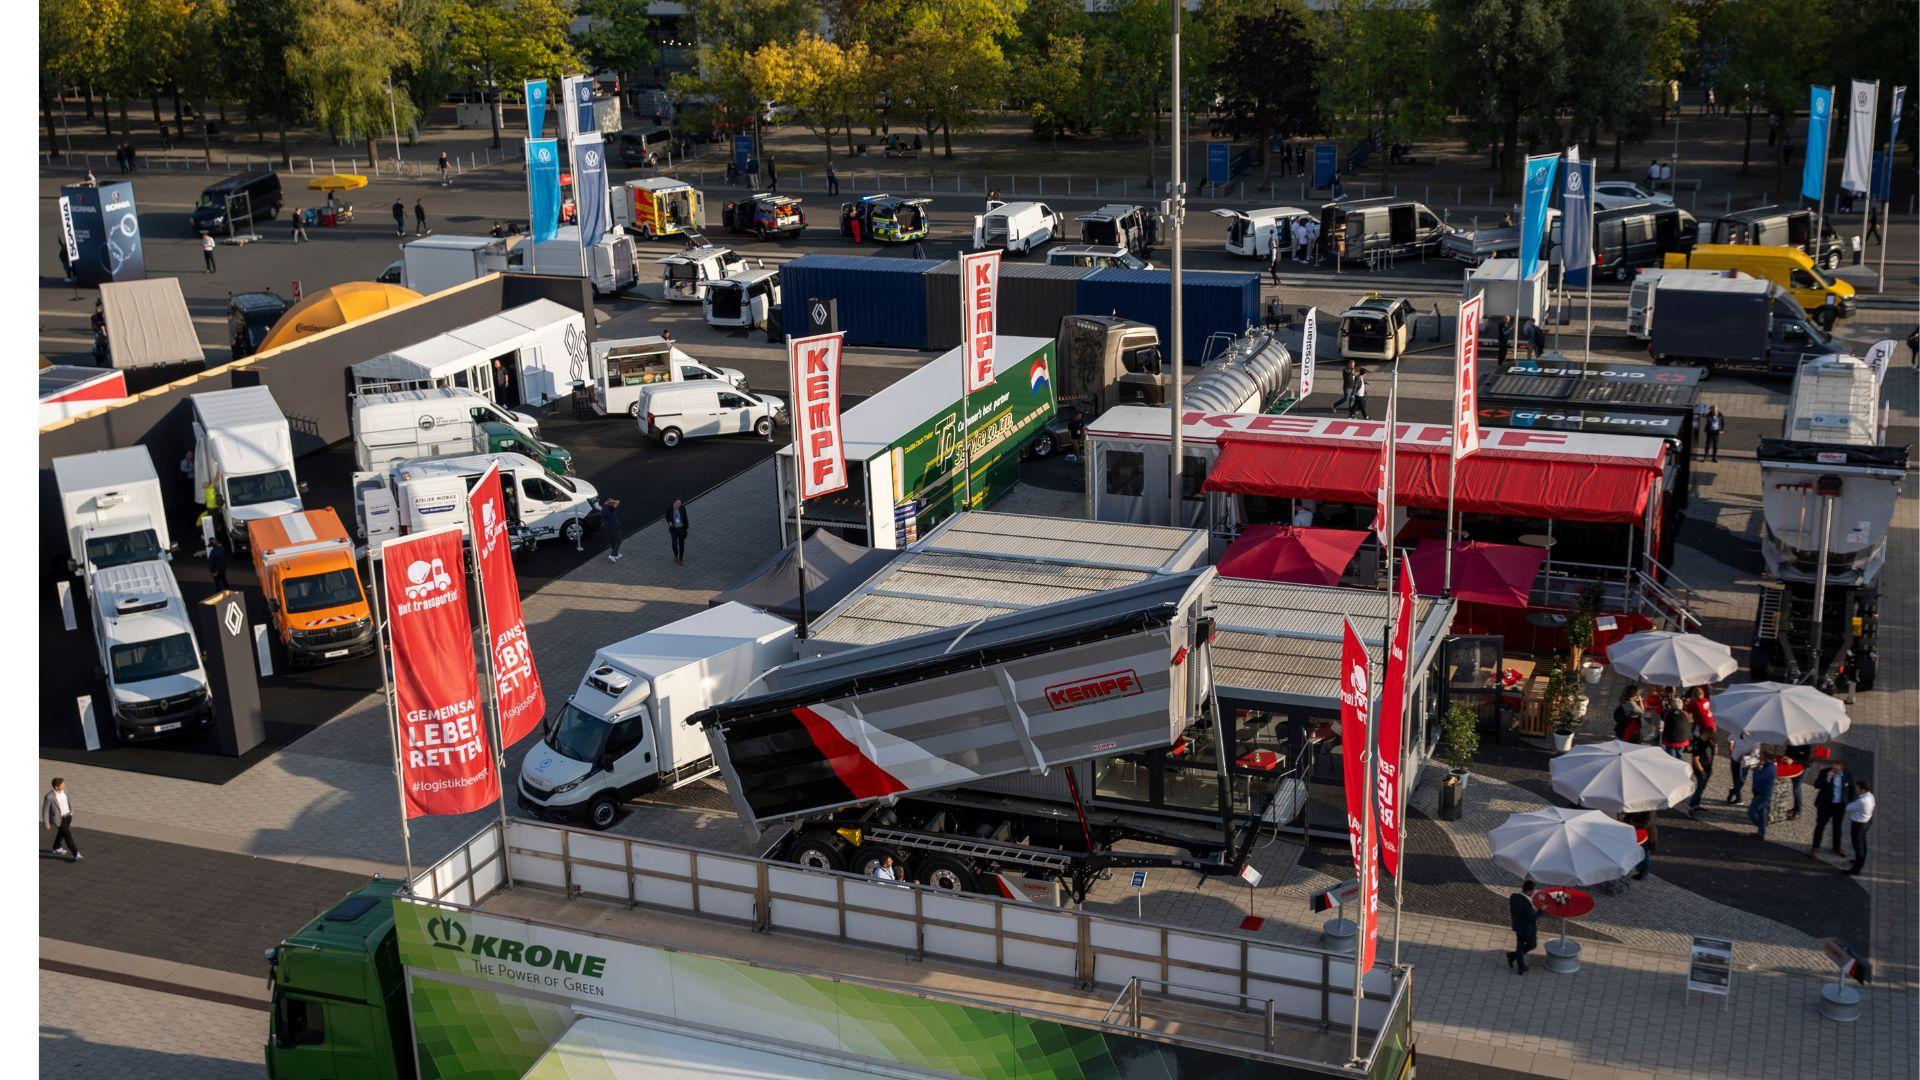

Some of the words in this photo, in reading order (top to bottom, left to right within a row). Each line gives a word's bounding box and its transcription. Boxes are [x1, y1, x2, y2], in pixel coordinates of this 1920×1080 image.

[63, 203, 77, 257] SCANIA
[975, 262, 993, 382] KEMPF
[1507, 365, 1646, 379] crossland
[806, 347, 834, 486] KEMPF
[1515, 411, 1670, 427] crossland
[1050, 676, 1133, 705] KEMPF
[407, 696, 475, 722] GEMEINSA
[471, 934, 607, 978] KRONE
